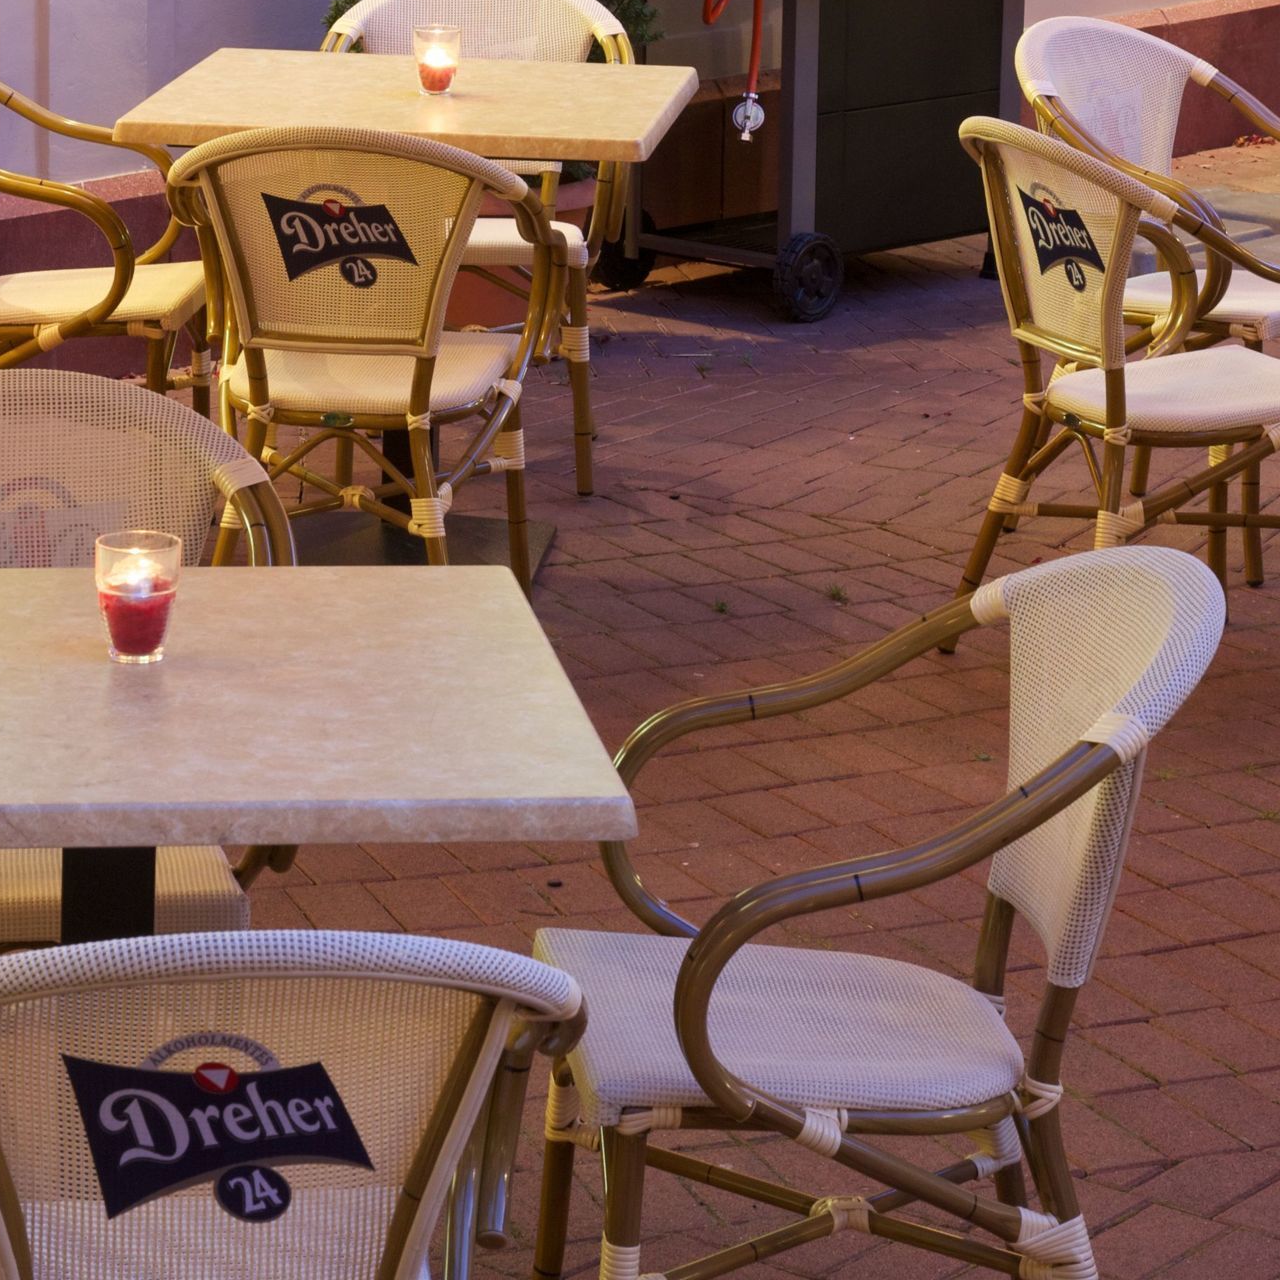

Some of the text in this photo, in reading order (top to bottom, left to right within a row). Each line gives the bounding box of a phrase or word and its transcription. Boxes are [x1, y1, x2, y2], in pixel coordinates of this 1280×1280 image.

[280, 211, 398, 254] Dreher
[1028, 206, 1091, 250] Dreher
[346, 259, 372, 284] 24
[1067, 263, 1083, 285] 24
[149, 1033, 274, 1068] ALKOHOLMENTES
[98, 1081, 338, 1167] Dreher
[228, 1169, 282, 1215] 24
